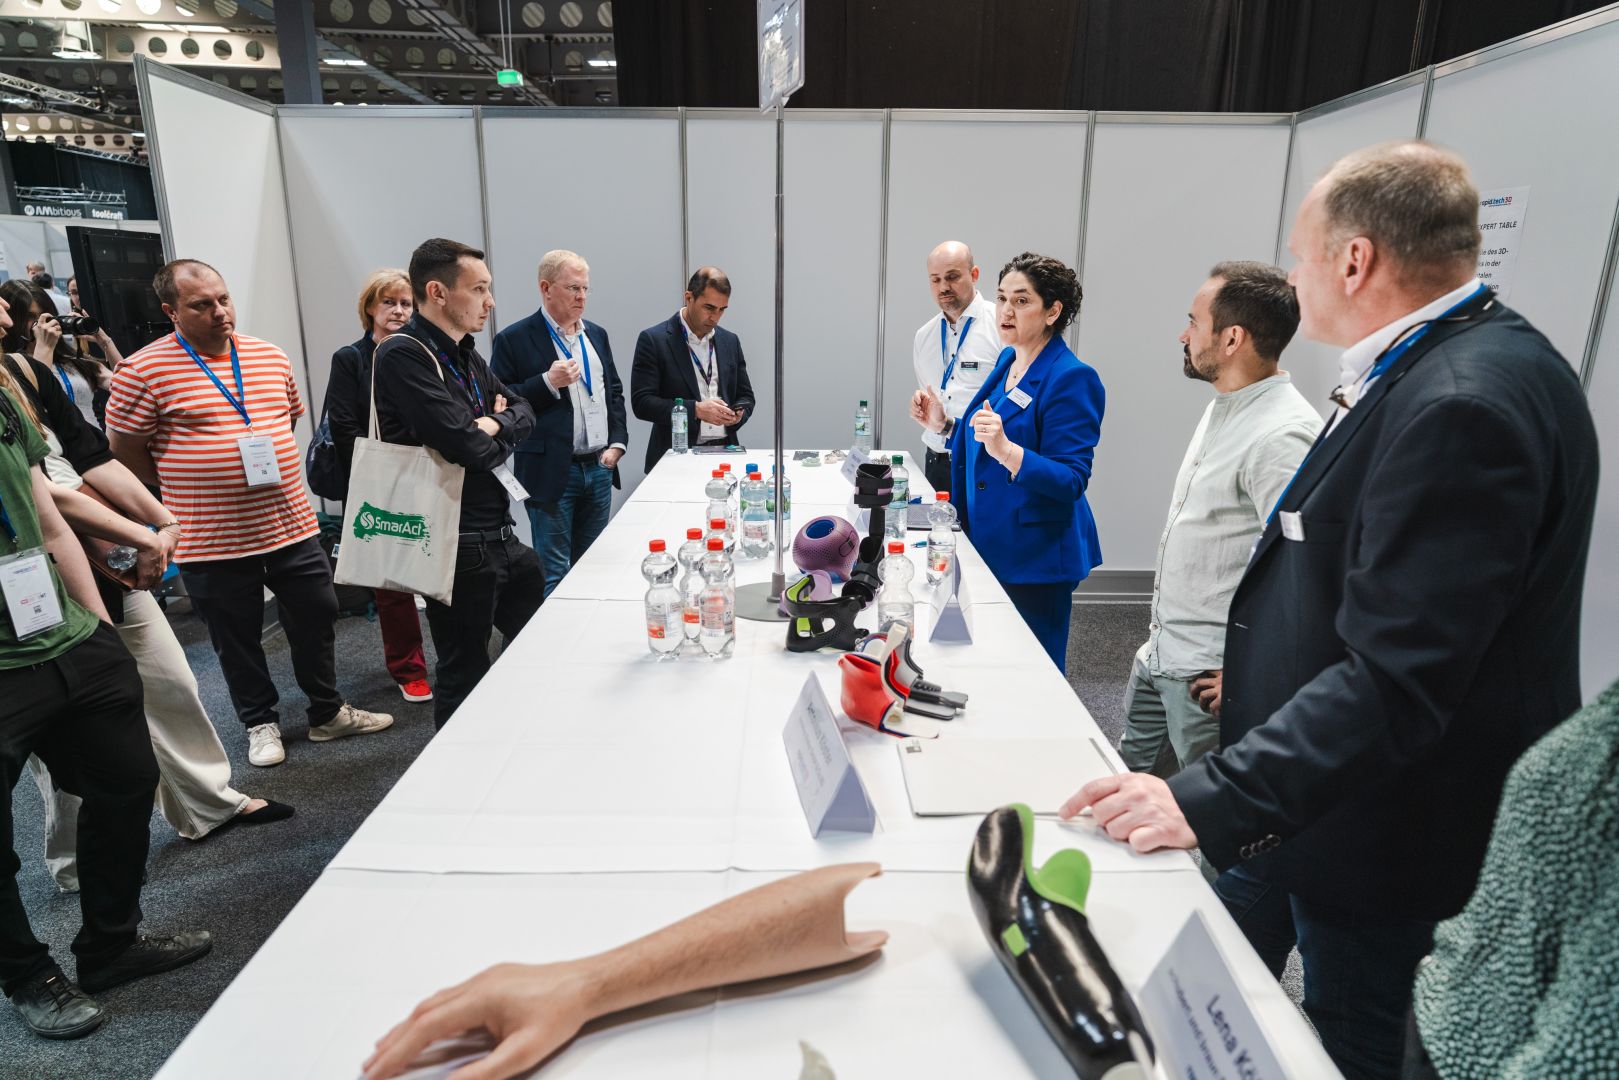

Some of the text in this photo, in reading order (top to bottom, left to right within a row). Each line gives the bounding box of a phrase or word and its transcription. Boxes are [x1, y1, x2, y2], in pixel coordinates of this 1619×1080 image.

[35, 205, 82, 216] AMbitious
[1499, 220, 1517, 229] TABLE
[1498, 247, 1509, 255] 3D-
[1491, 259, 1501, 267] der
[375, 516, 422, 536] SmarAct
[1206, 994, 1238, 1053] Lena
